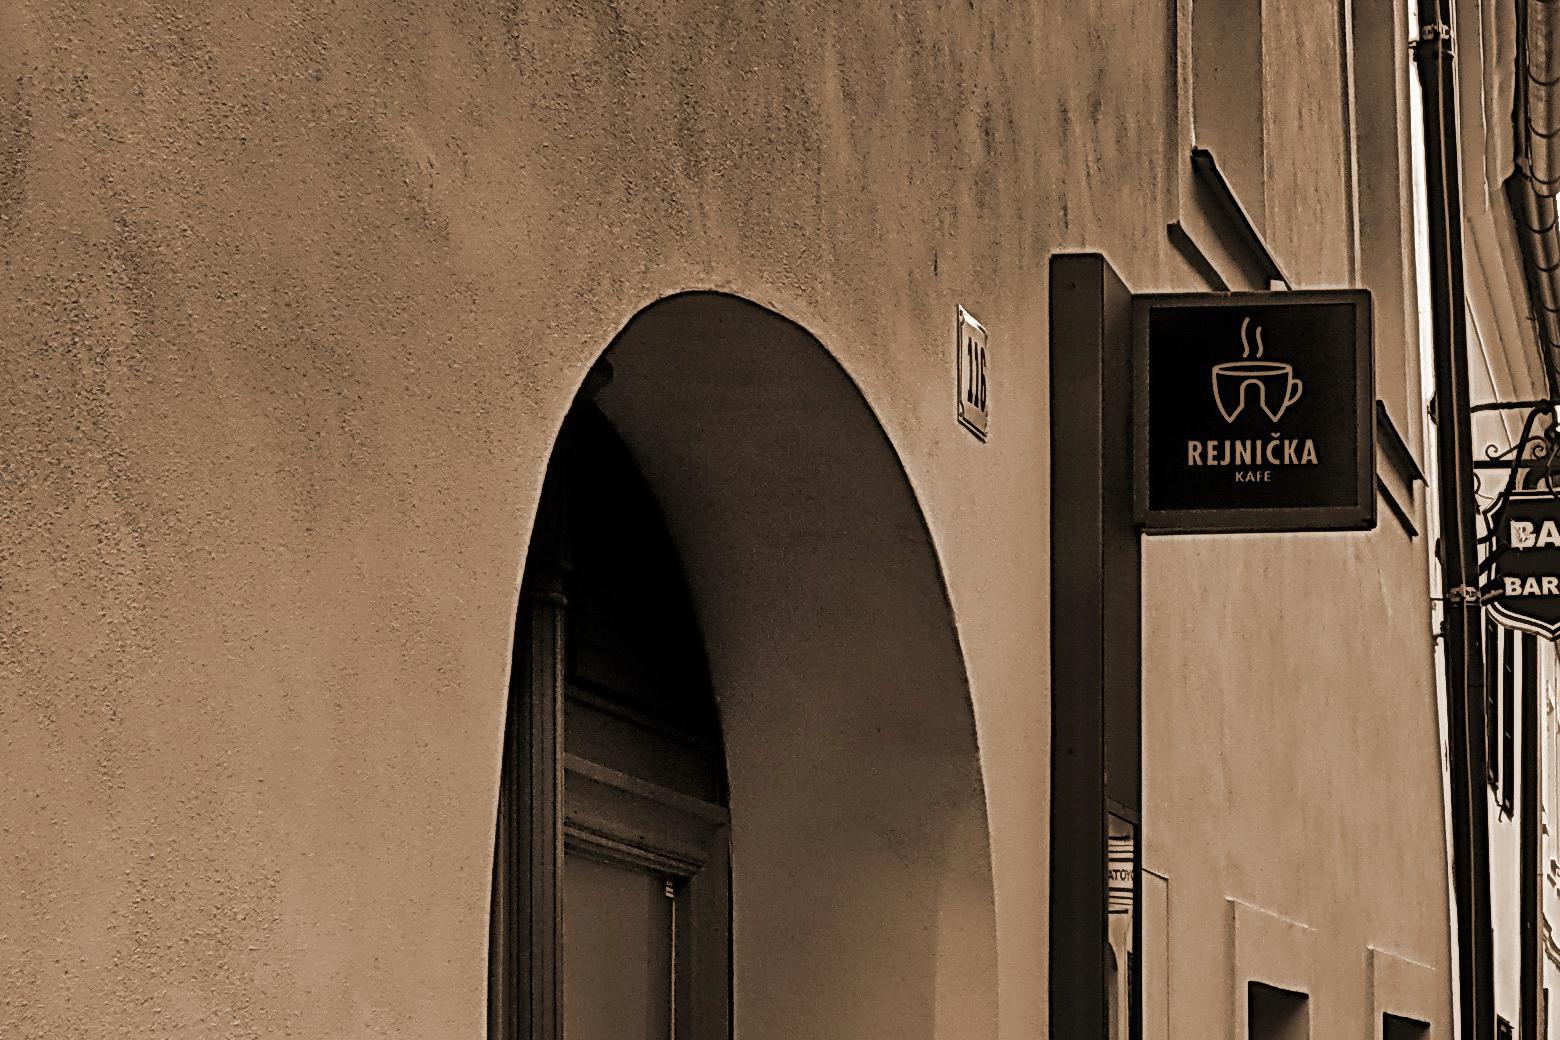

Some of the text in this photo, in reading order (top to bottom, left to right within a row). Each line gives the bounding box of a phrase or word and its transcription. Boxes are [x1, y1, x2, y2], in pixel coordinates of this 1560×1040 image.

[966, 336, 987, 413] 116
[1187, 432, 1319, 466] REJNIČKA
[1235, 470, 1272, 482] KAFE
